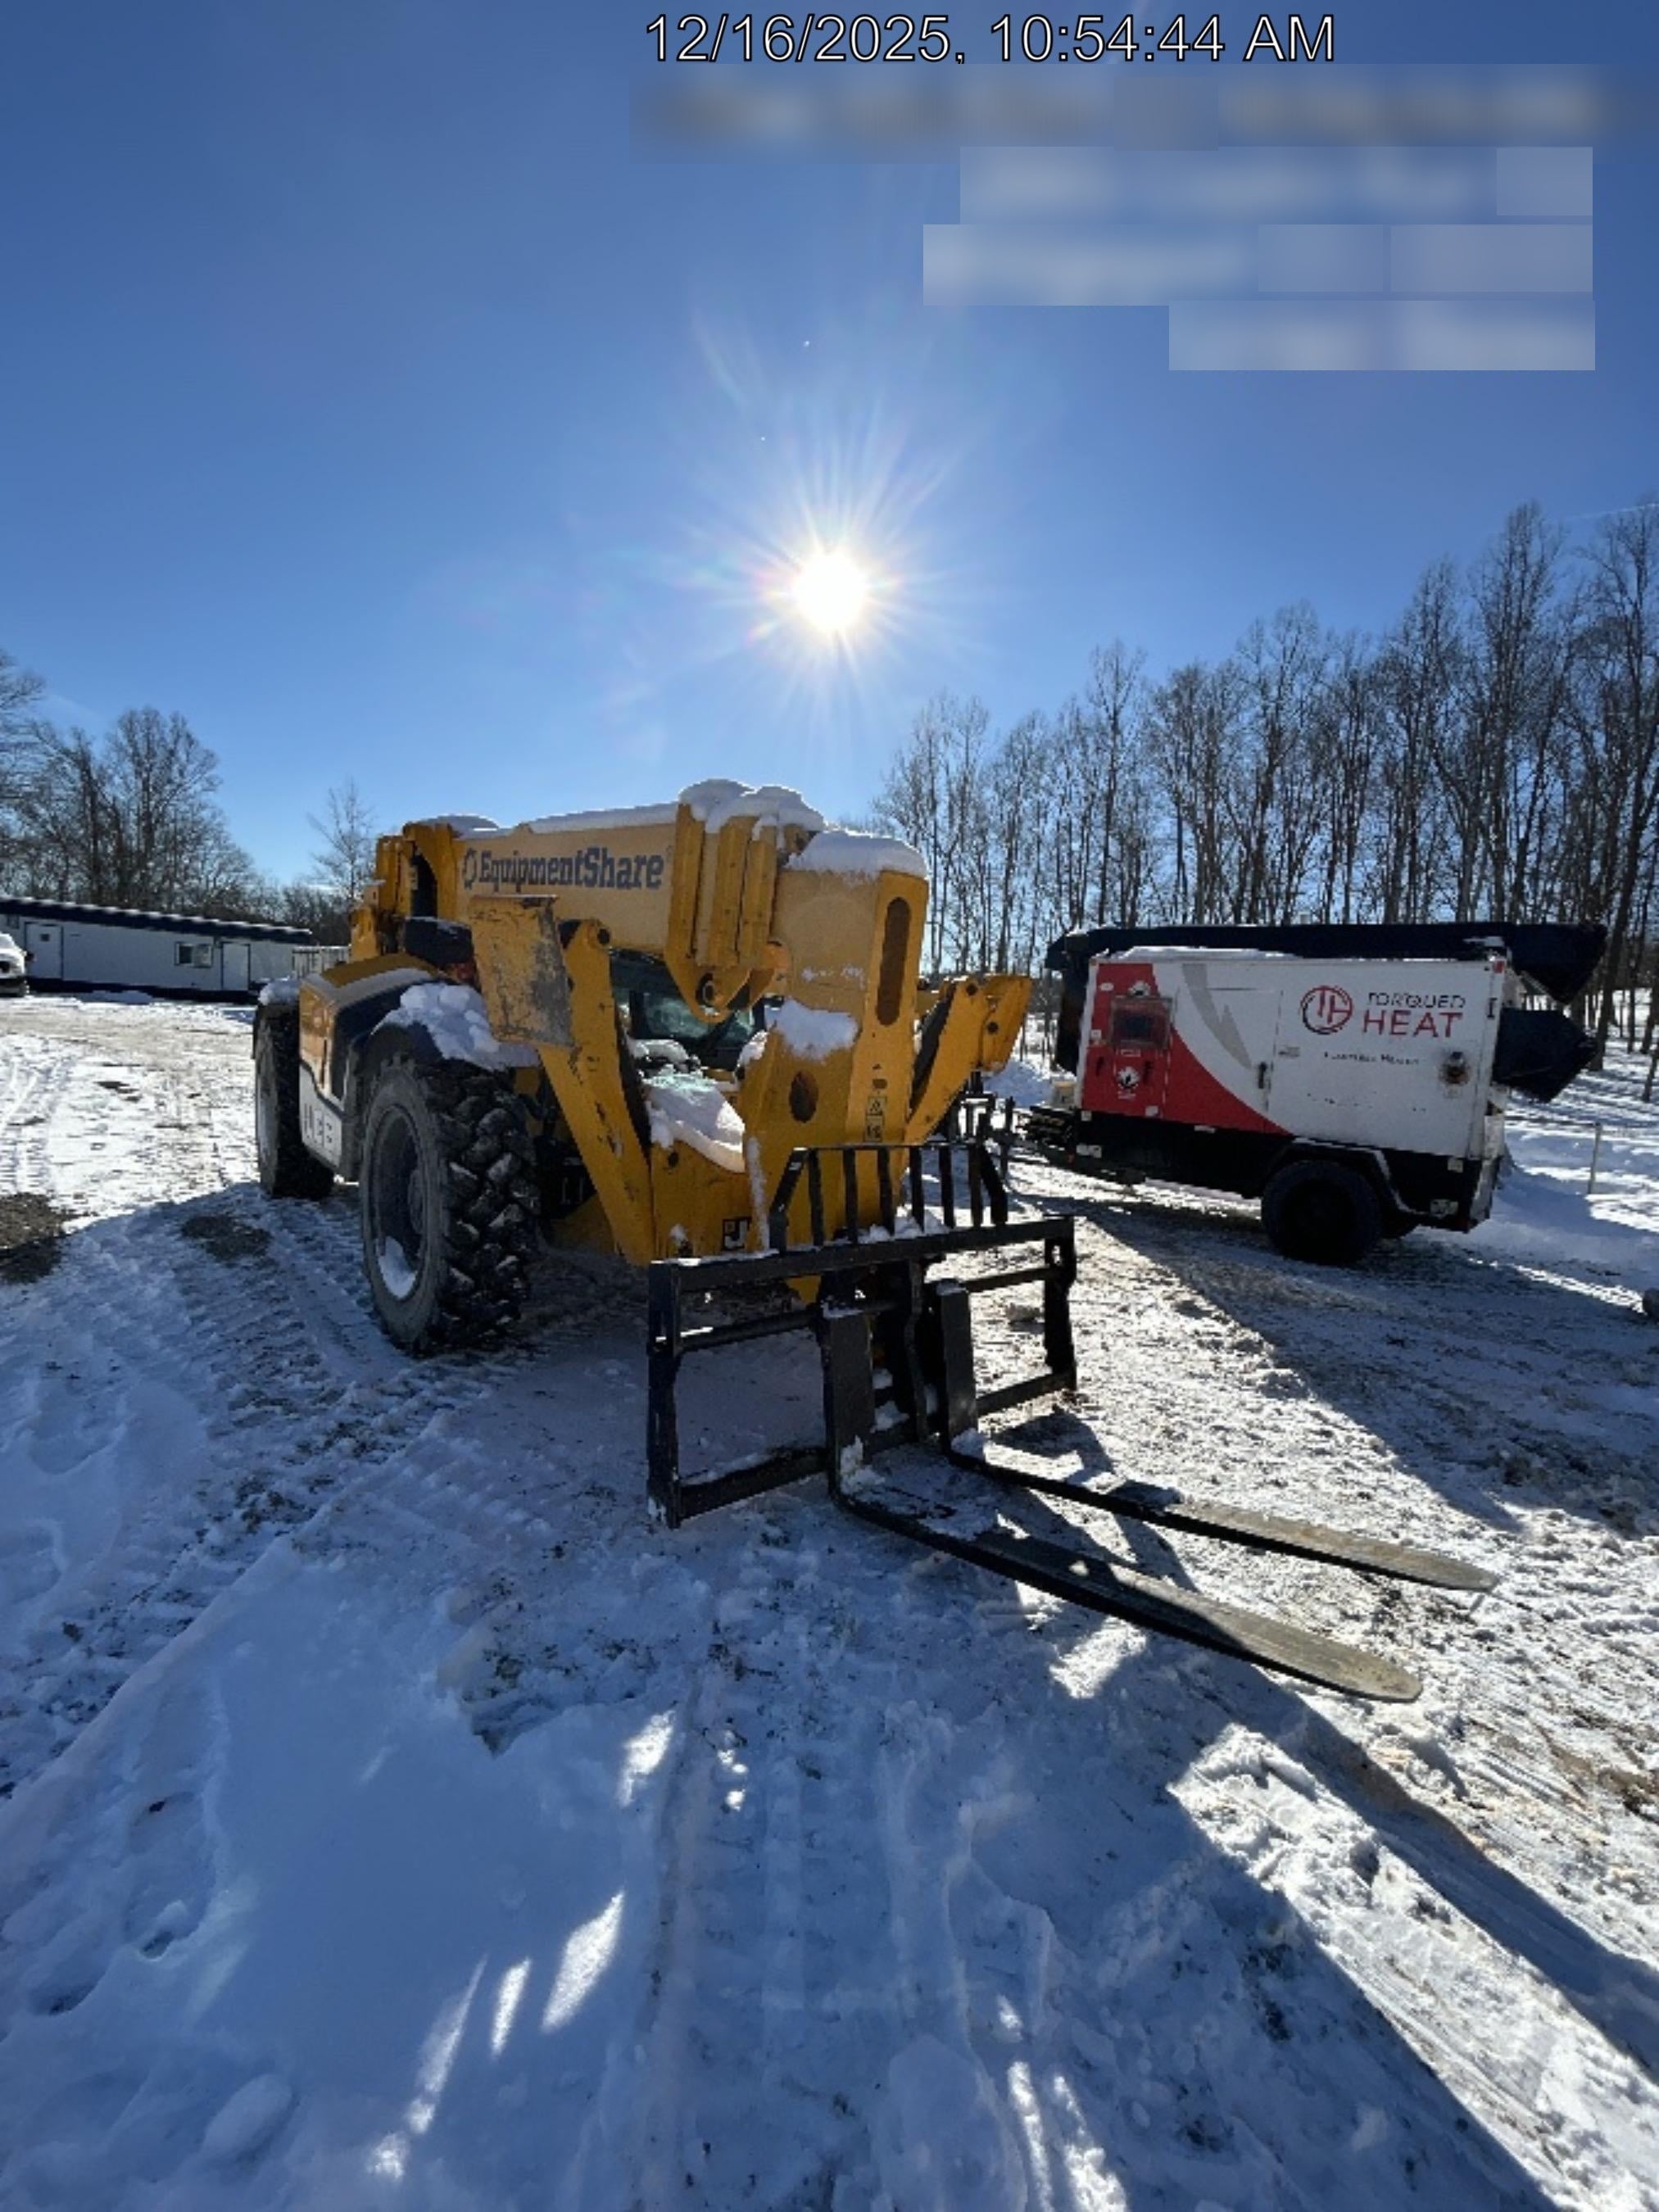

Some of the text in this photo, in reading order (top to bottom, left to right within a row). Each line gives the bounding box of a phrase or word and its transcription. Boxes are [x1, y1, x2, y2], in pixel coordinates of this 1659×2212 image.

[479, 845, 664, 893] EquipmentShare
[1367, 991, 1466, 1009] TORQUED
[1362, 1009, 1463, 1038] HEAT
